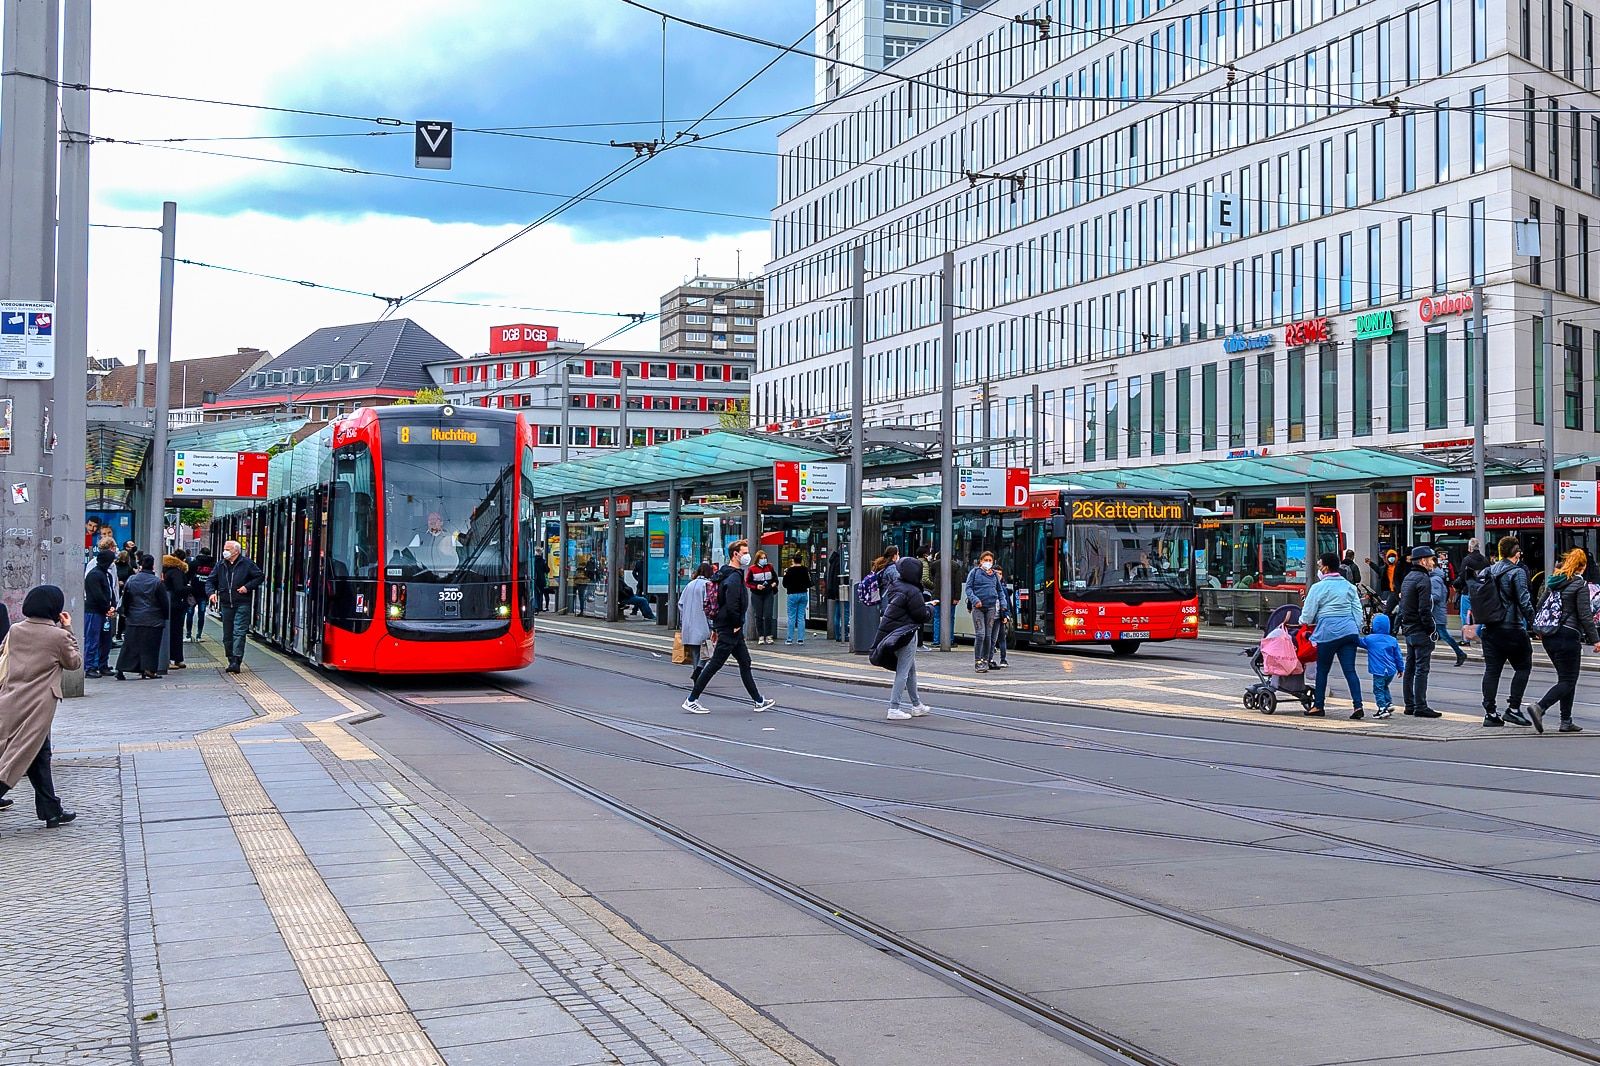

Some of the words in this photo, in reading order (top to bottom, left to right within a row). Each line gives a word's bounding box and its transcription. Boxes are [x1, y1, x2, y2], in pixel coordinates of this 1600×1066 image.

[1220, 200, 1232, 227] E
[1434, 293, 1473, 317] adagio
[1285, 317, 1328, 347] REWE
[1357, 310, 1393, 333] DONYA
[502, 328, 520, 342] DGB
[524, 328, 548, 342] DGB
[401, 426, 410, 443] 8
[432, 428, 477, 444] Huchting
[252, 473, 266, 495] F
[777, 479, 789, 500] E
[1014, 485, 1028, 506] D
[1415, 492, 1427, 511] C
[438, 591, 464, 601] 3209
[1121, 616, 1150, 624] MAN
